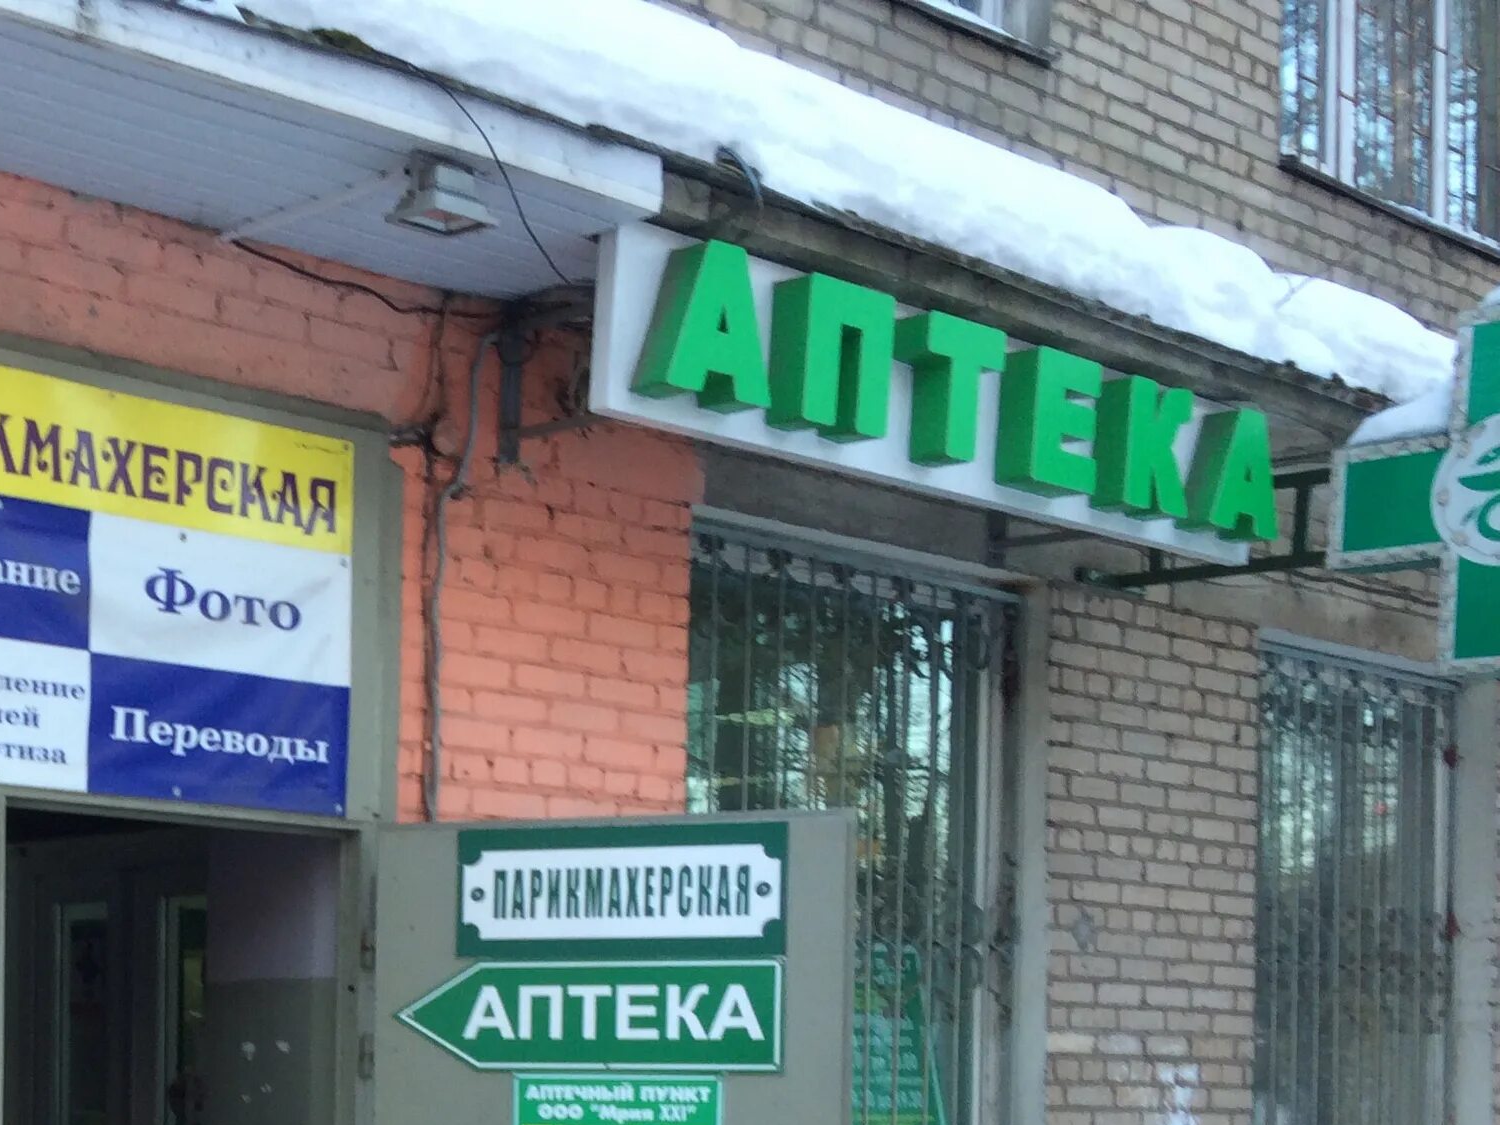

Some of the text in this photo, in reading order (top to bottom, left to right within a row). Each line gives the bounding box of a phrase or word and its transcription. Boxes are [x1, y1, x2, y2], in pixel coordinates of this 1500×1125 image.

[631, 238, 1277, 541] АПТЕКА
[145, 567, 301, 631] Фото
[110, 705, 329, 766] Переводы
[493, 864, 750, 919] ПАРИКМАХЕРСКАЯ
[462, 983, 765, 1041] АПТЕКА
[525, 1082, 711, 1102] АПТЕЧНЫЙ ПУНКТ
[537, 1103, 584, 1120] ООО
